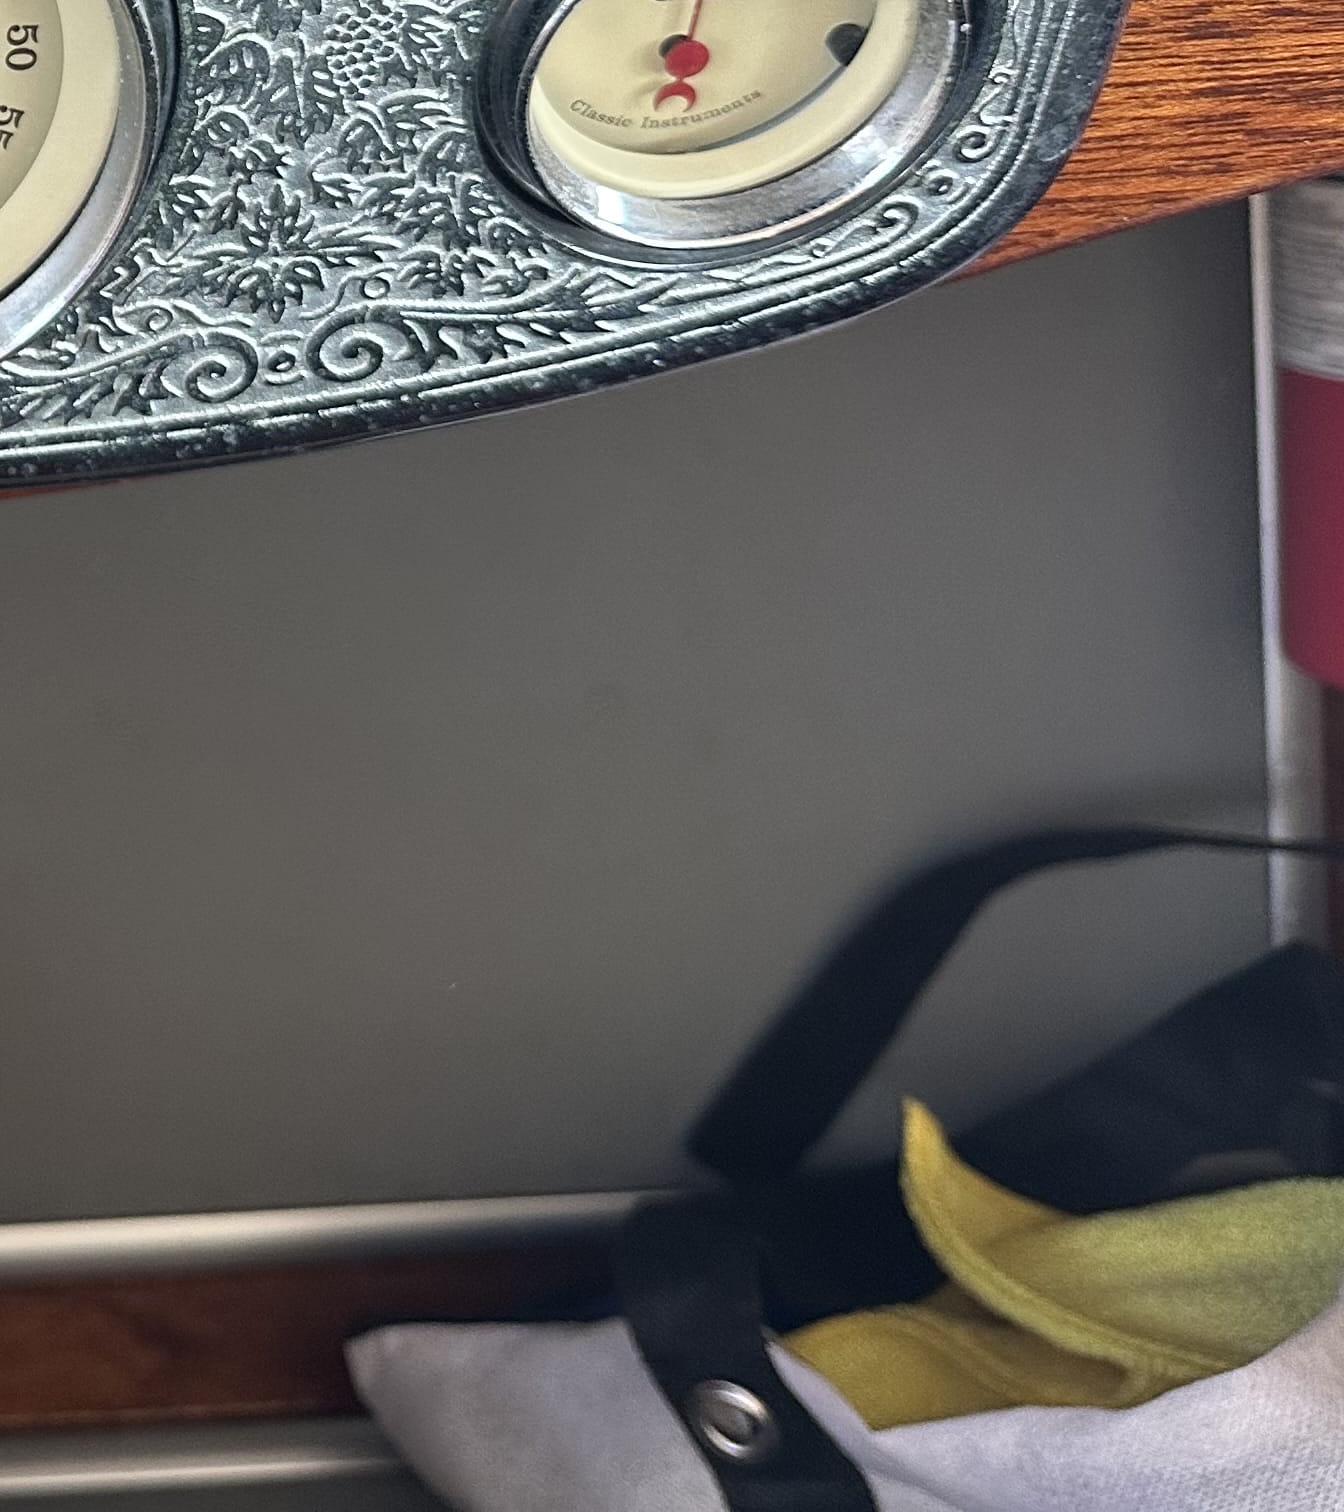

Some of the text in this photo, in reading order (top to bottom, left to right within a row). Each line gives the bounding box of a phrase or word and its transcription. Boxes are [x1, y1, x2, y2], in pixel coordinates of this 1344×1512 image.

[5, 24, 38, 72] 50
[568, 89, 761, 129] Classic Instruments
